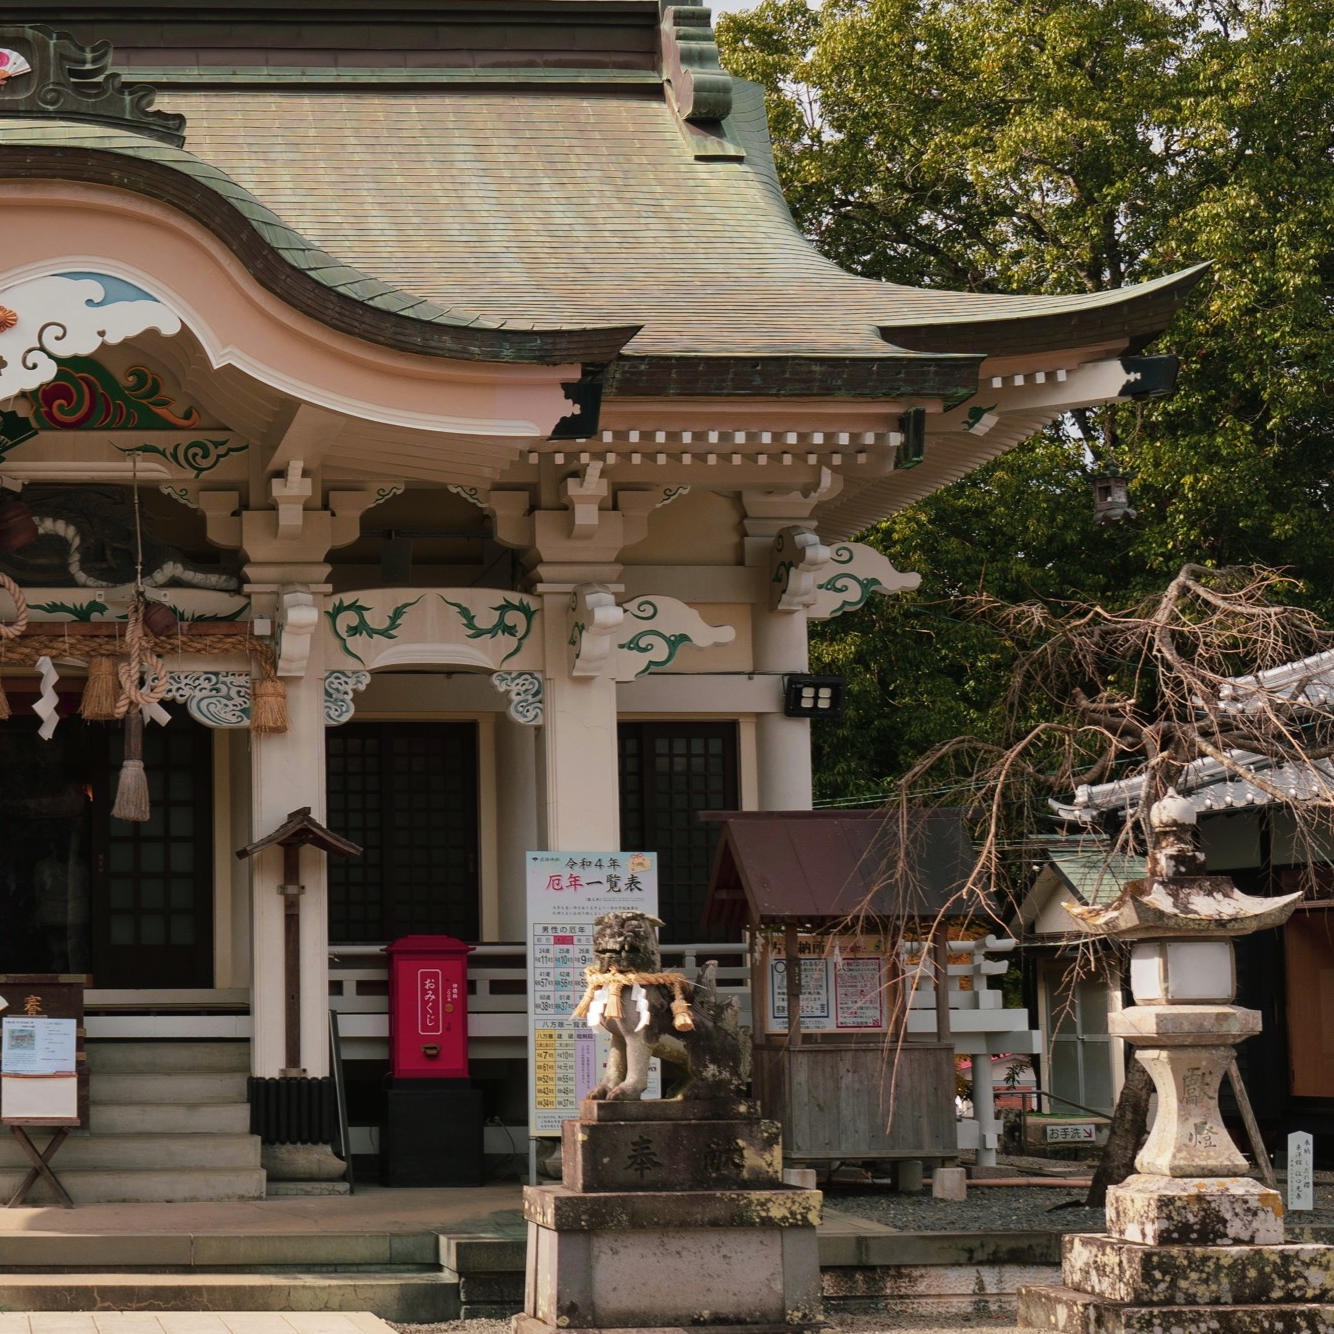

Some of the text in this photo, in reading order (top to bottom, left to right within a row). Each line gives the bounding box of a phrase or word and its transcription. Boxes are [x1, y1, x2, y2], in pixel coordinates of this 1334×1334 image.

[546, 873, 642, 893] 厄年一覧表
[541, 926, 585, 934] 男性の厄年
[773, 940, 825, 955] 古納所
[424, 978, 436, 1026] おみくじ
[1049, 1127, 1082, 1139] お手洗
[1303, 1139, 1311, 1155] 奉納
